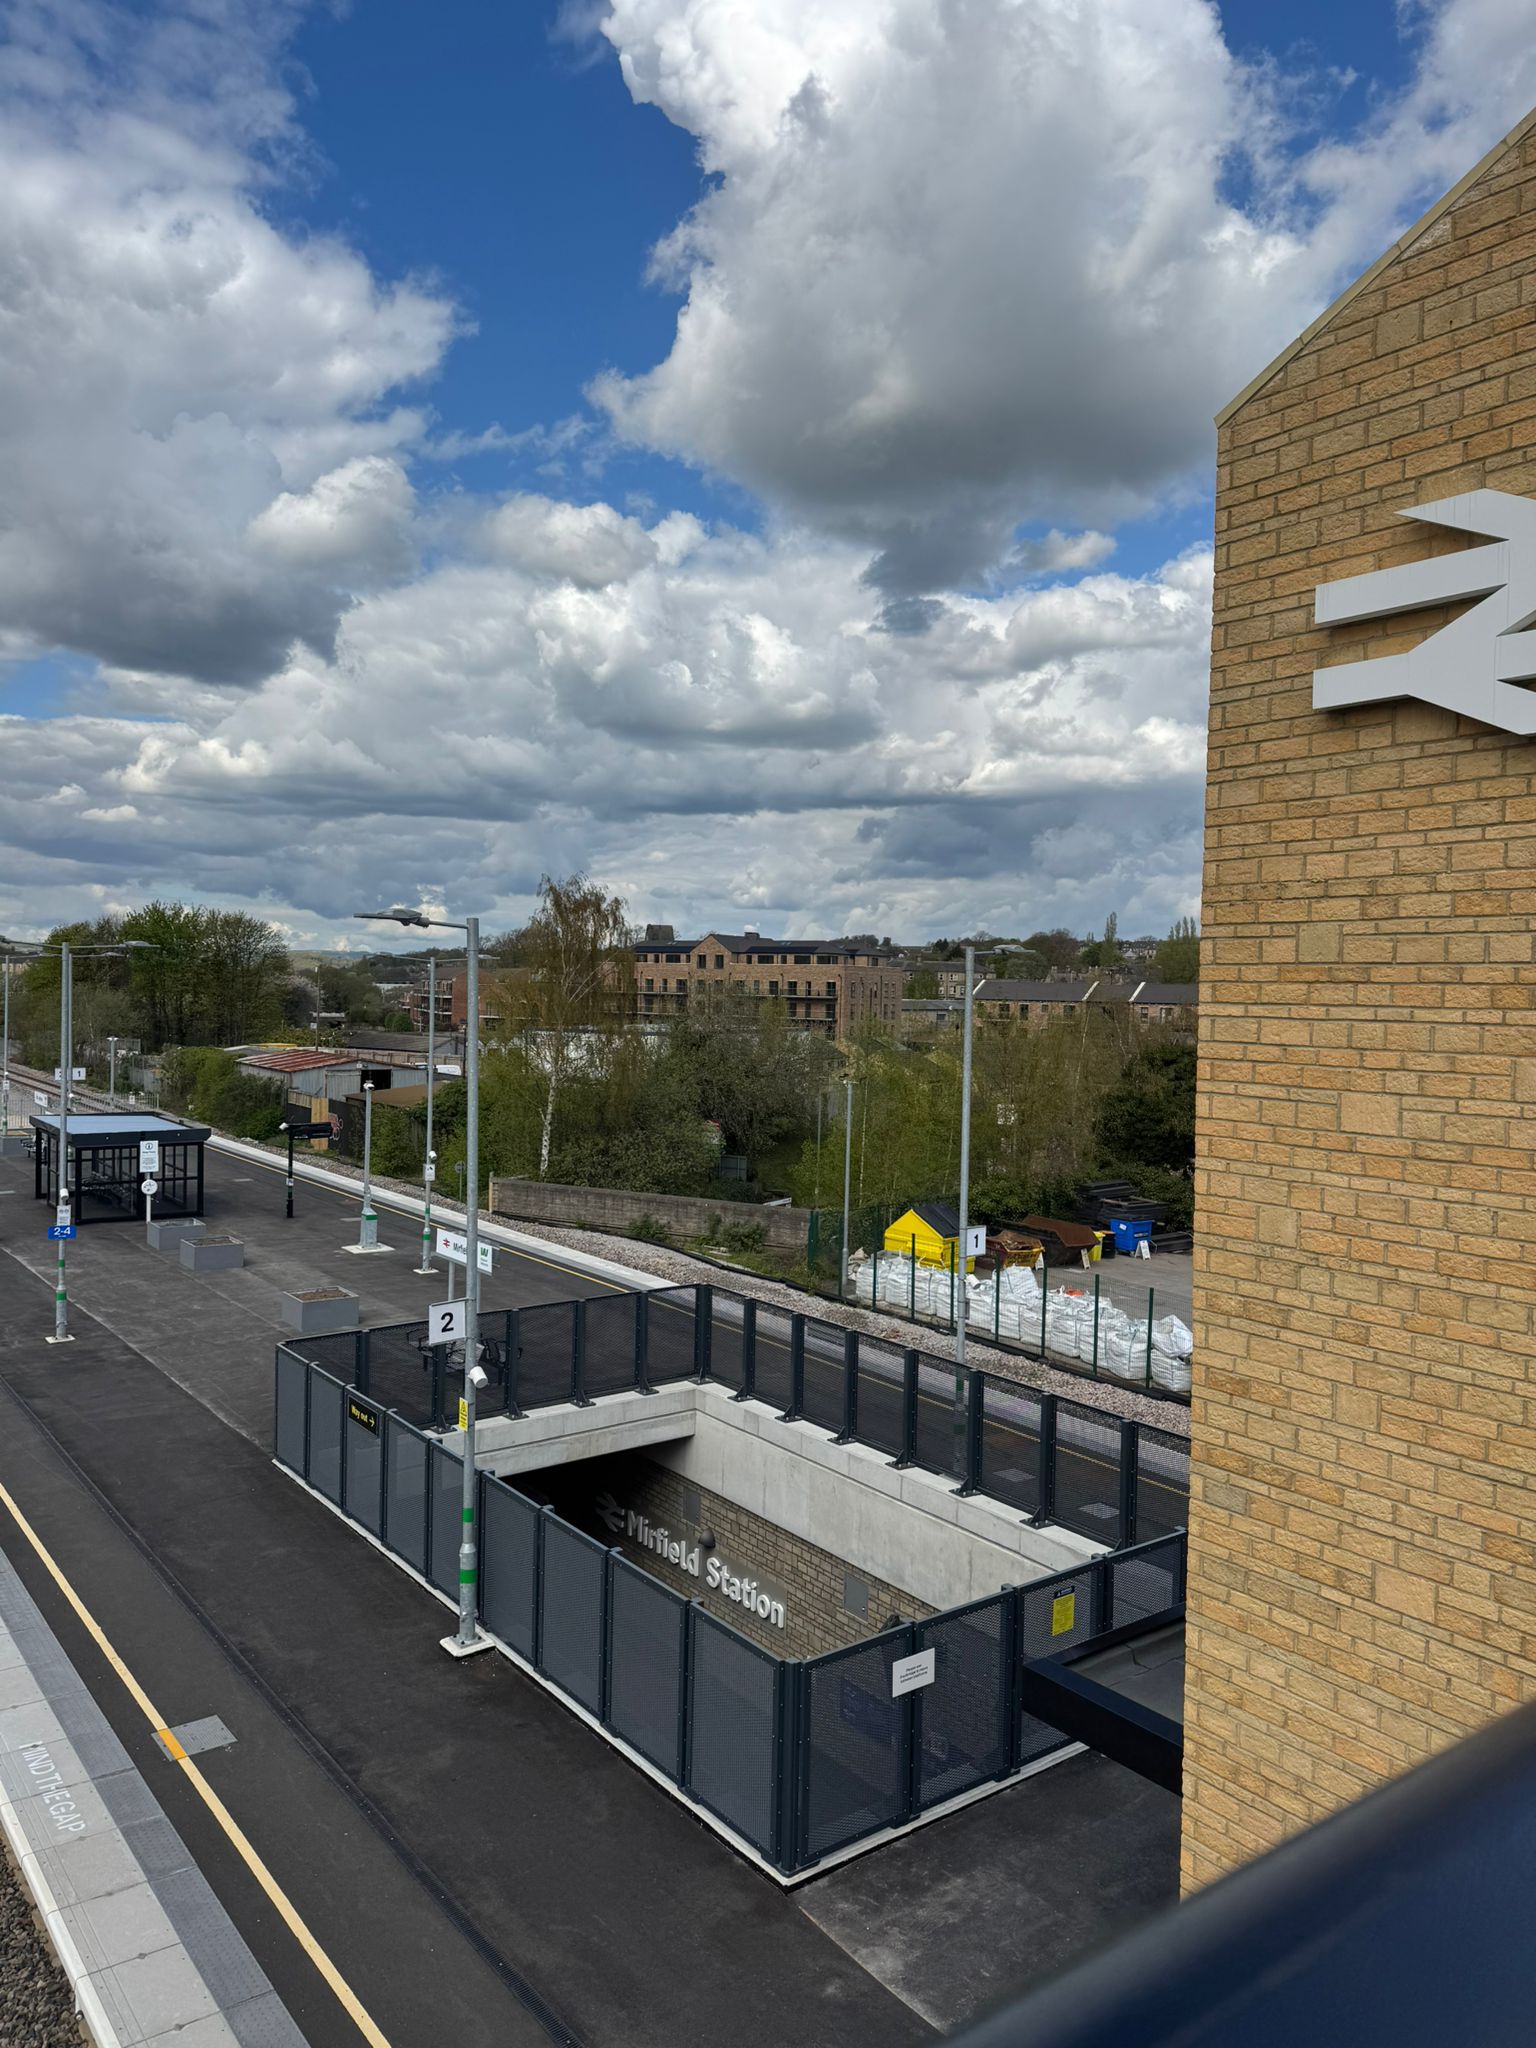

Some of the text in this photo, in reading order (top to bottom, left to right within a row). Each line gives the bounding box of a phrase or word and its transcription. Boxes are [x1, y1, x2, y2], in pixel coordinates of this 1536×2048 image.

[53, 1226, 71, 1236] 2-4
[974, 1233, 979, 1249] 1
[440, 1312, 454, 1333] 2
[627, 1510, 785, 1629] Mirfield Station
[18, 1740, 86, 1832] MIND THE GAP
